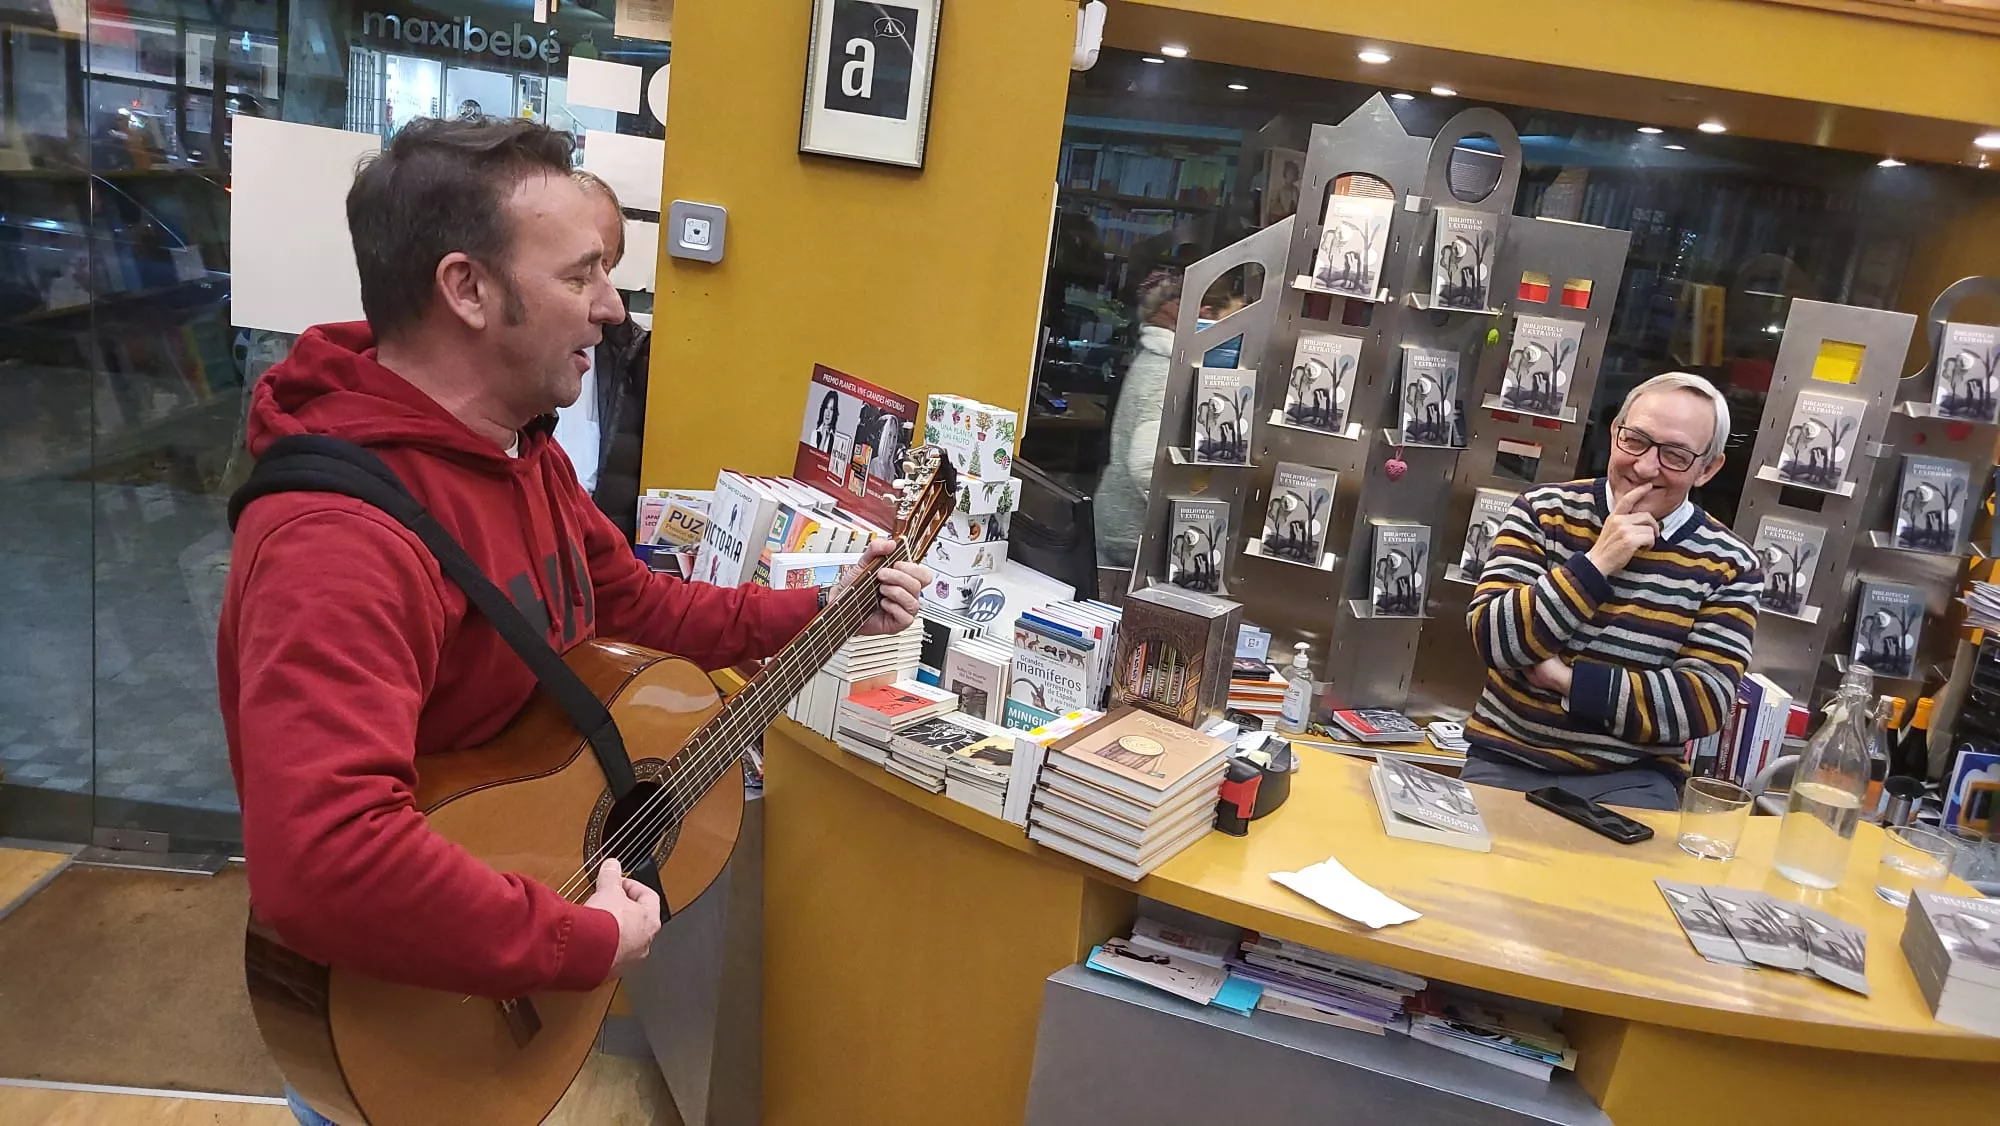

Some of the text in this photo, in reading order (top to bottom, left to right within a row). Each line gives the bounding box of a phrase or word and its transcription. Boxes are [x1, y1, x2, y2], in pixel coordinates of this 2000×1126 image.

[883, 22, 894, 34] A
[841, 37, 876, 99] a
[703, 519, 743, 564] VICTORIA
[1021, 654, 1044, 668] Grandes
[1016, 660, 1081, 692] mamíferos
[1044, 681, 1073, 695] terrestres
[1056, 690, 1076, 703] España
[1006, 718, 1020, 729] DE
[1008, 707, 1050, 726] MINIGU
[1136, 717, 1210, 747] PINOCHO
